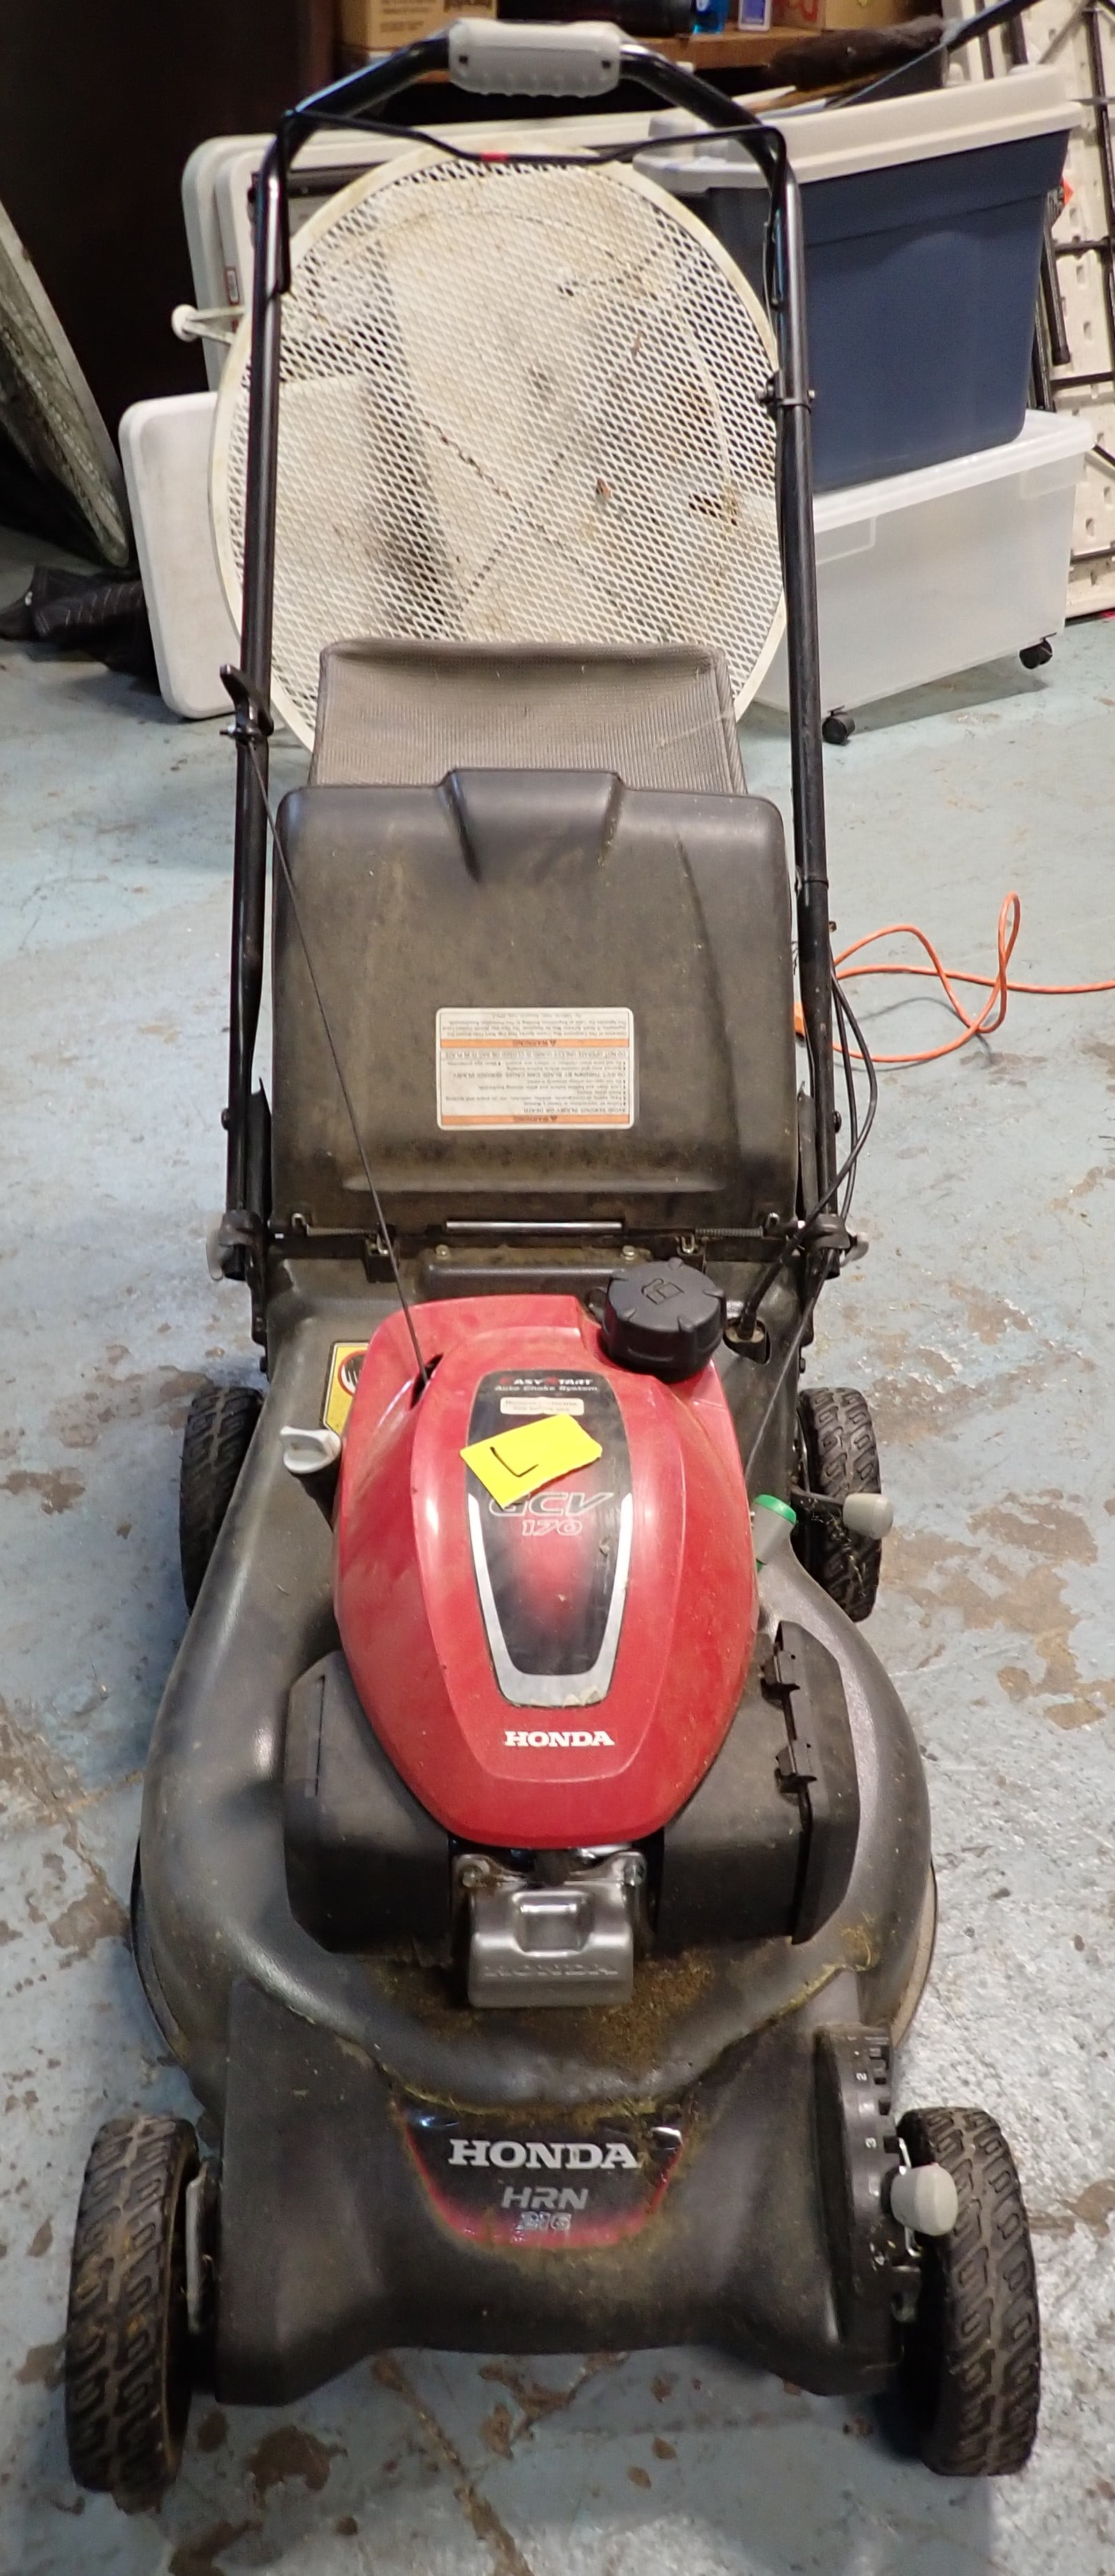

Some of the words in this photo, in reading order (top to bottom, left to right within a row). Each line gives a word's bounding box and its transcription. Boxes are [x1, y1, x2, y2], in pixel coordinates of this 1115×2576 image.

[522, 1519, 582, 1537] 170
[504, 1731, 615, 1747] HONDA
[448, 2139, 641, 2169] HONDA
[500, 2185, 590, 2210] HRN
